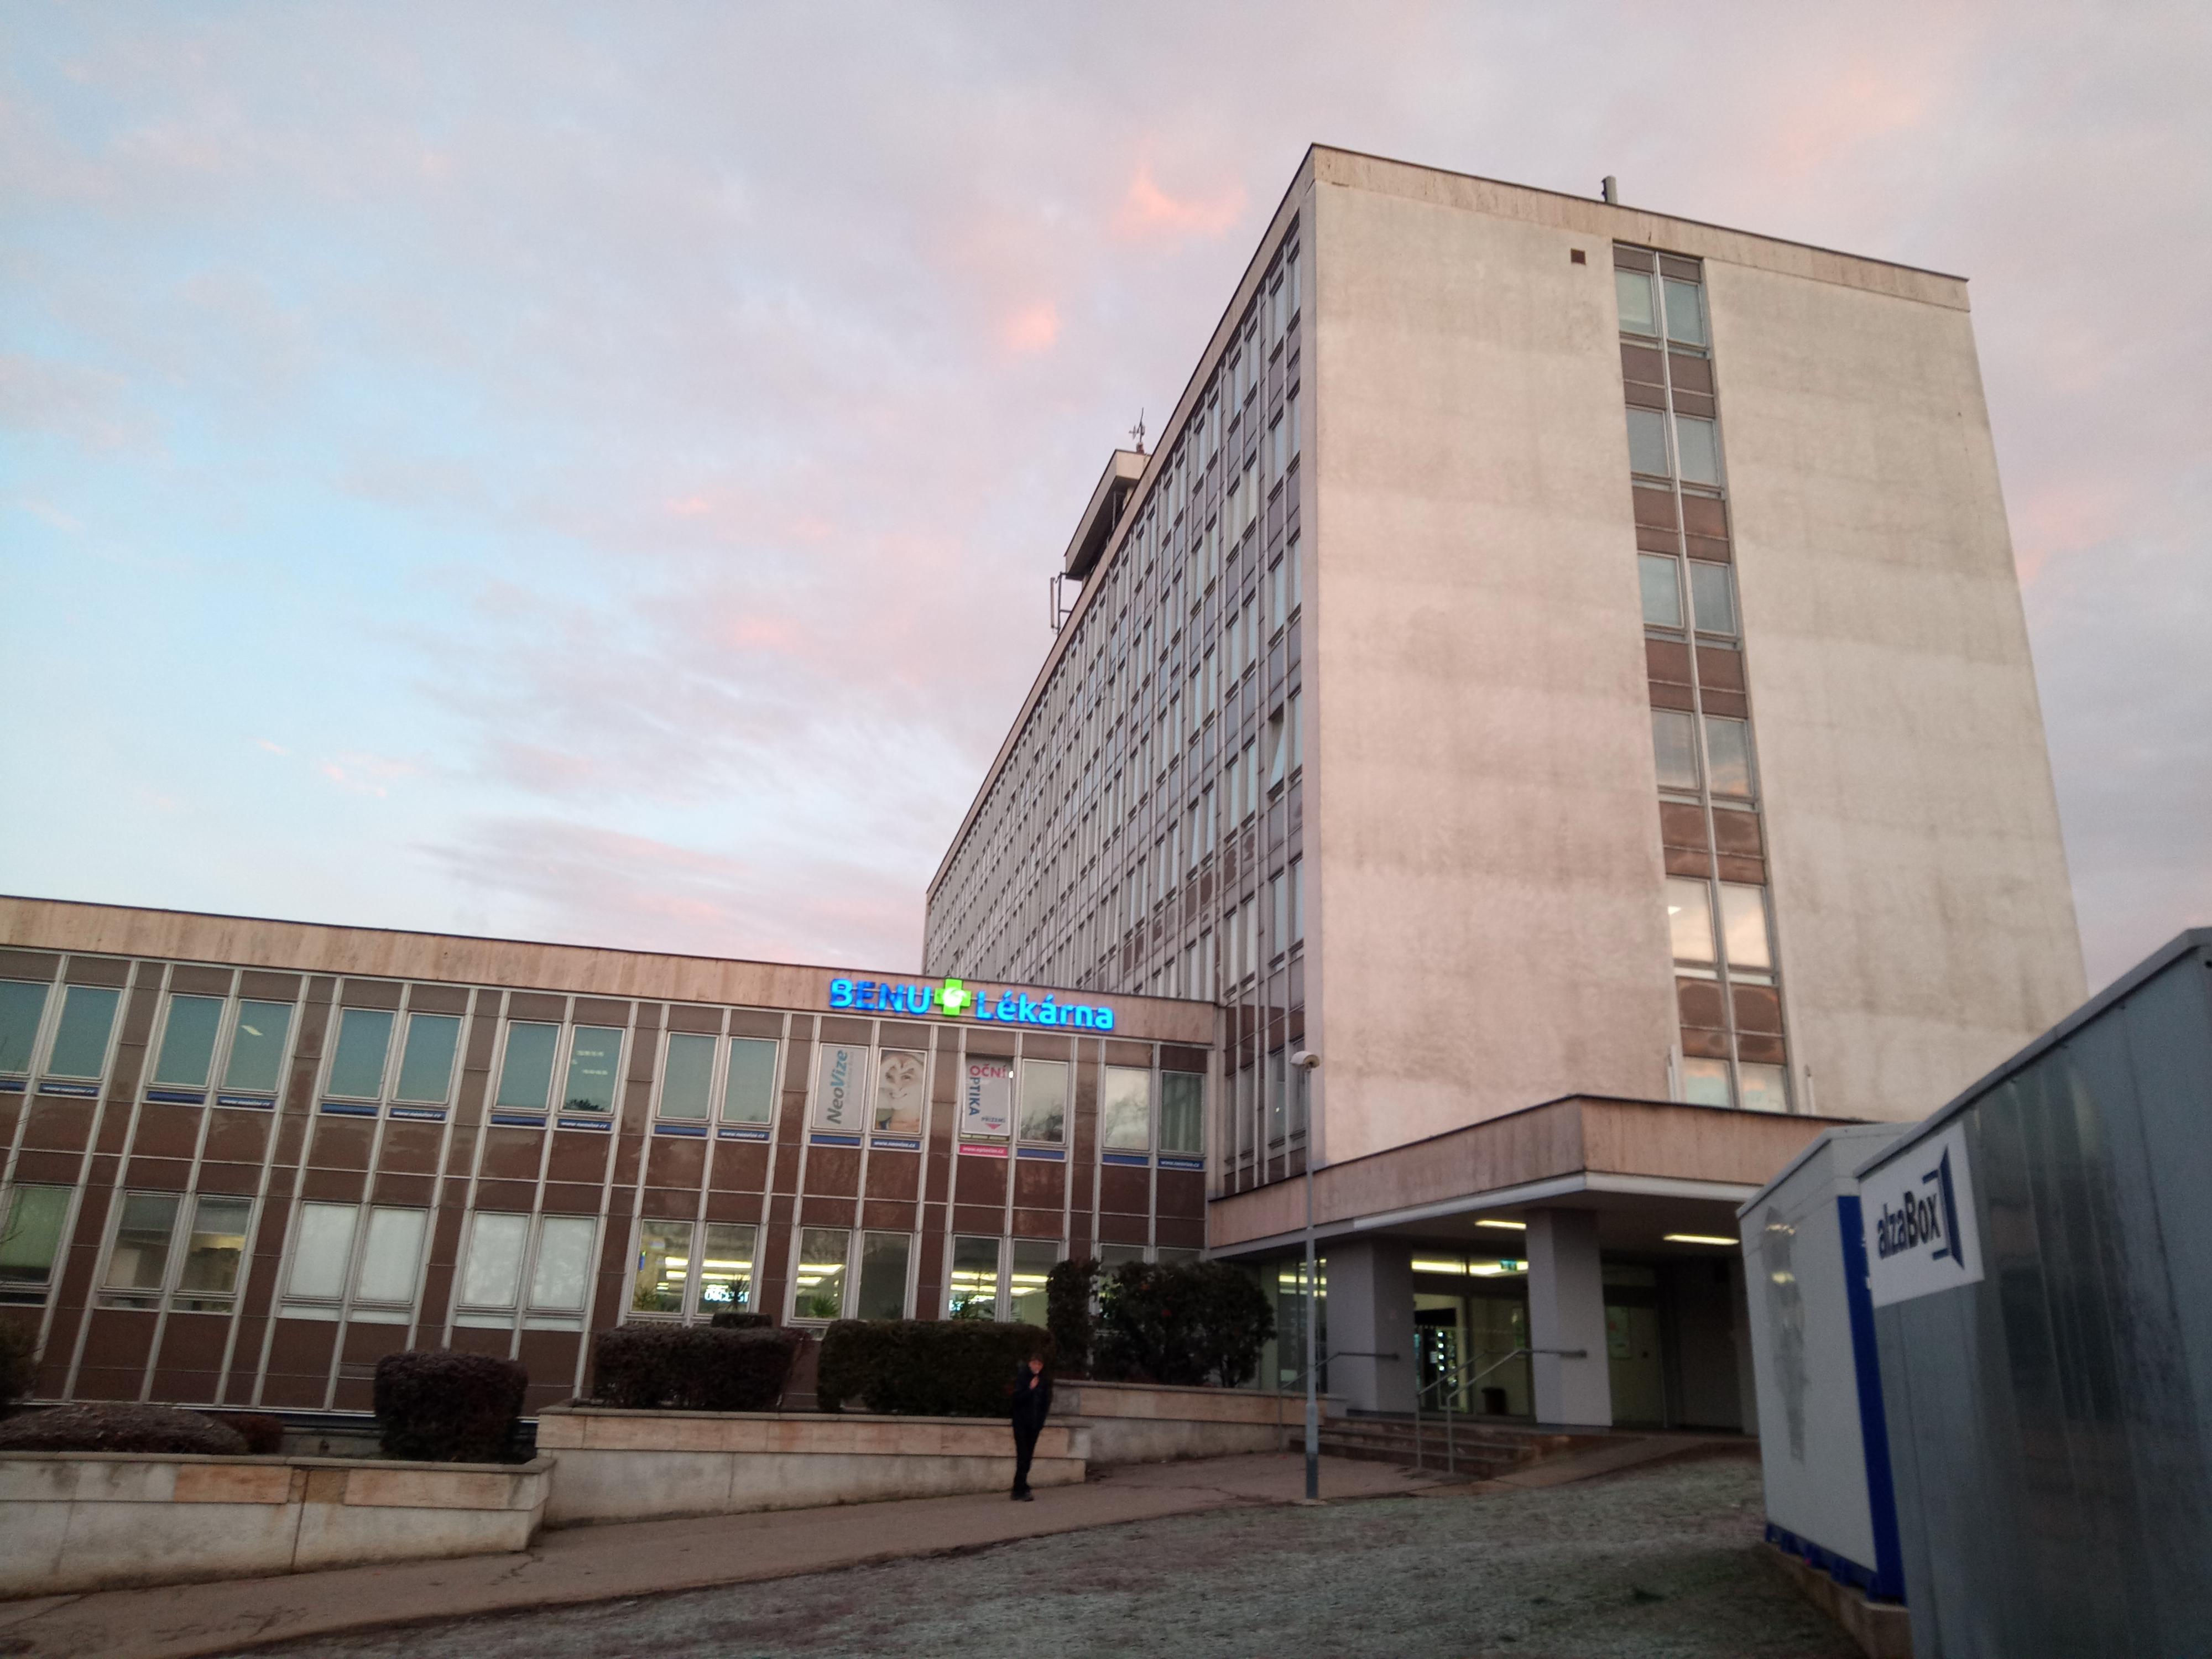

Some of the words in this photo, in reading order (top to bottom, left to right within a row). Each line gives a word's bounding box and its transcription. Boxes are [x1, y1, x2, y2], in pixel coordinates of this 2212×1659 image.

[830, 978, 932, 1015] BENU
[976, 989, 1115, 1031] Lékárna
[826, 1050, 848, 1124] NeoVize
[970, 1063, 1007, 1078] OČNÍ
[1877, 1191, 1941, 1260] alzaBox
